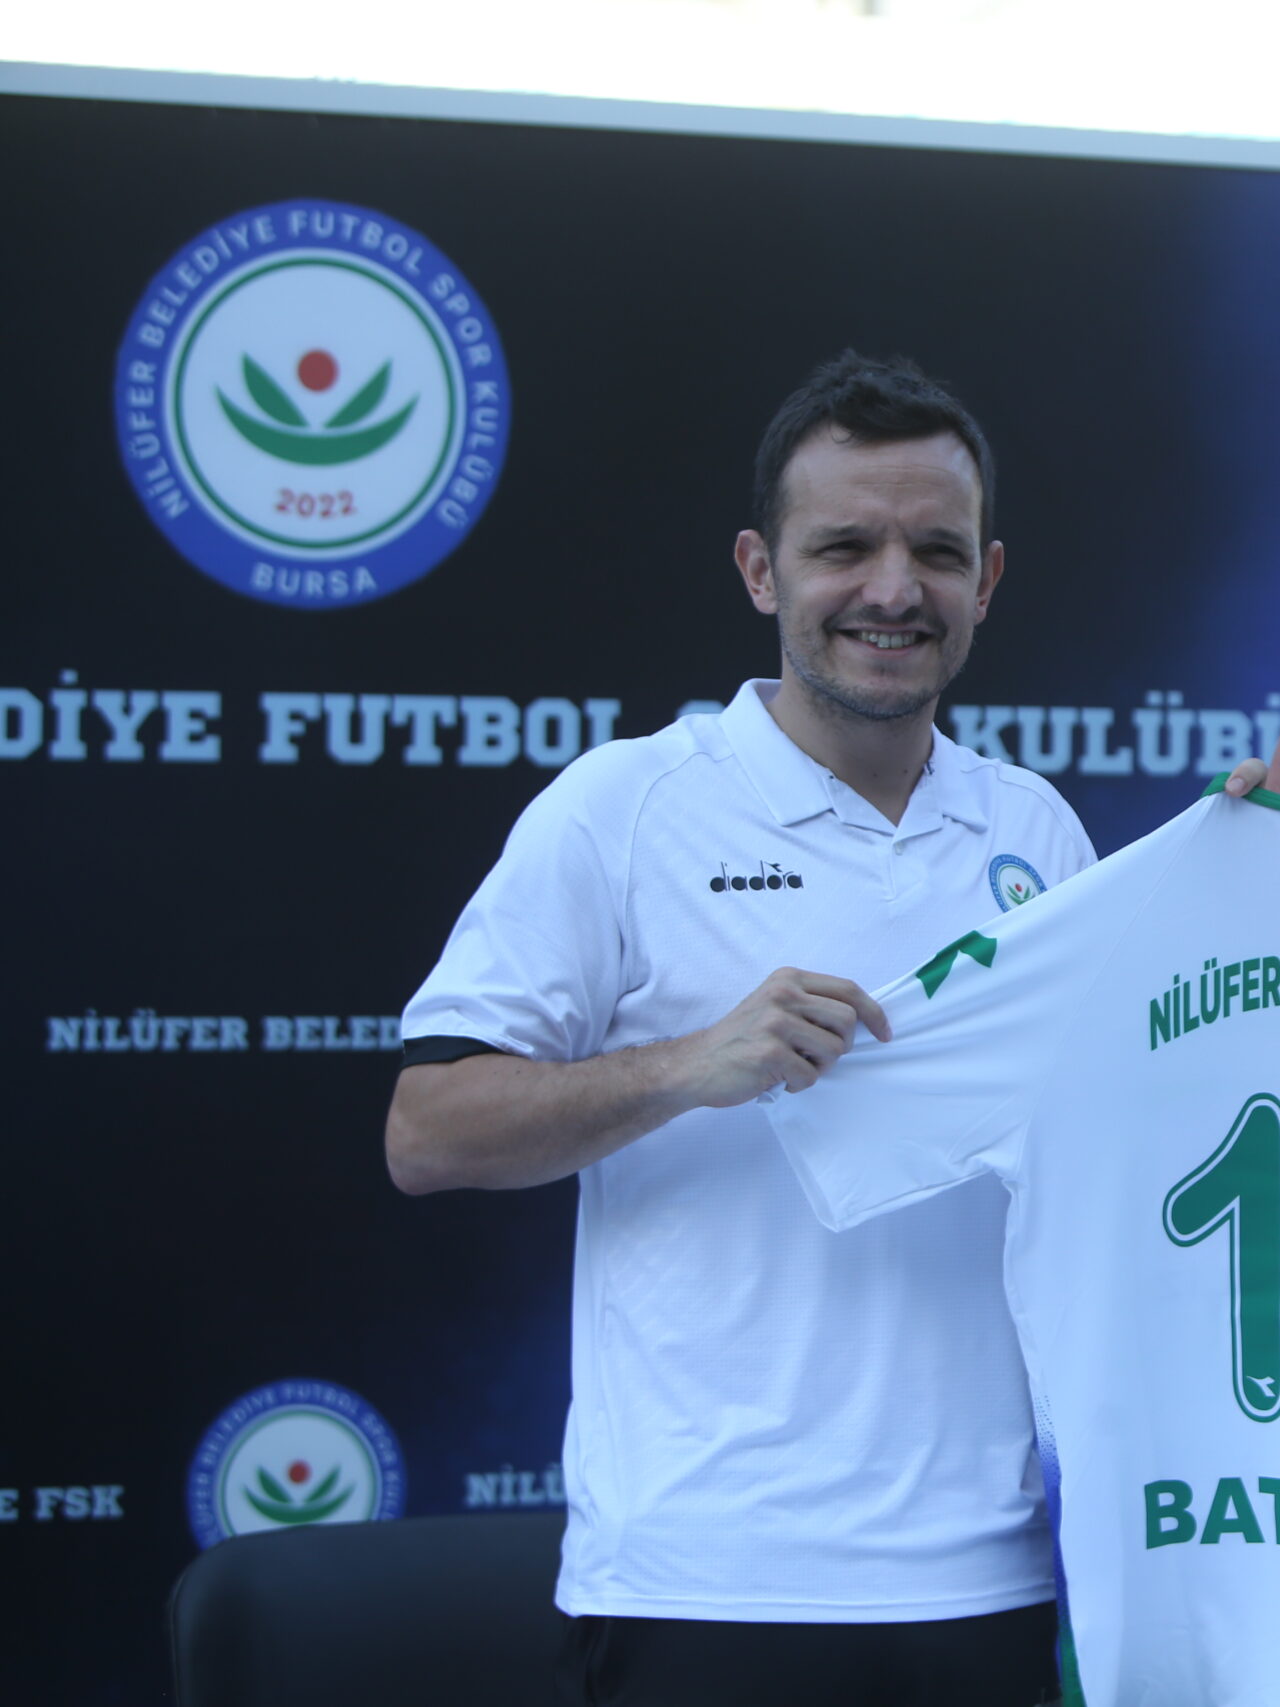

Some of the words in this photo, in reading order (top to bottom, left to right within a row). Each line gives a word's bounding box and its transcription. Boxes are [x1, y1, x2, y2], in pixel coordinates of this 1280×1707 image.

[288, 210, 424, 275] FUTBOL
[140, 214, 276, 347] BELEDİYE
[431, 273, 492, 366] SPOR
[129, 360, 190, 519] NİLÜFER
[438, 380, 500, 529] KULÜBÜ
[275, 488, 357, 519] 2022
[251, 562, 377, 596] BURSA
[710, 860, 803, 893] diadora
[47, 1009, 249, 1051] NİLÜFER
[36, 1485, 124, 1519] FSK
